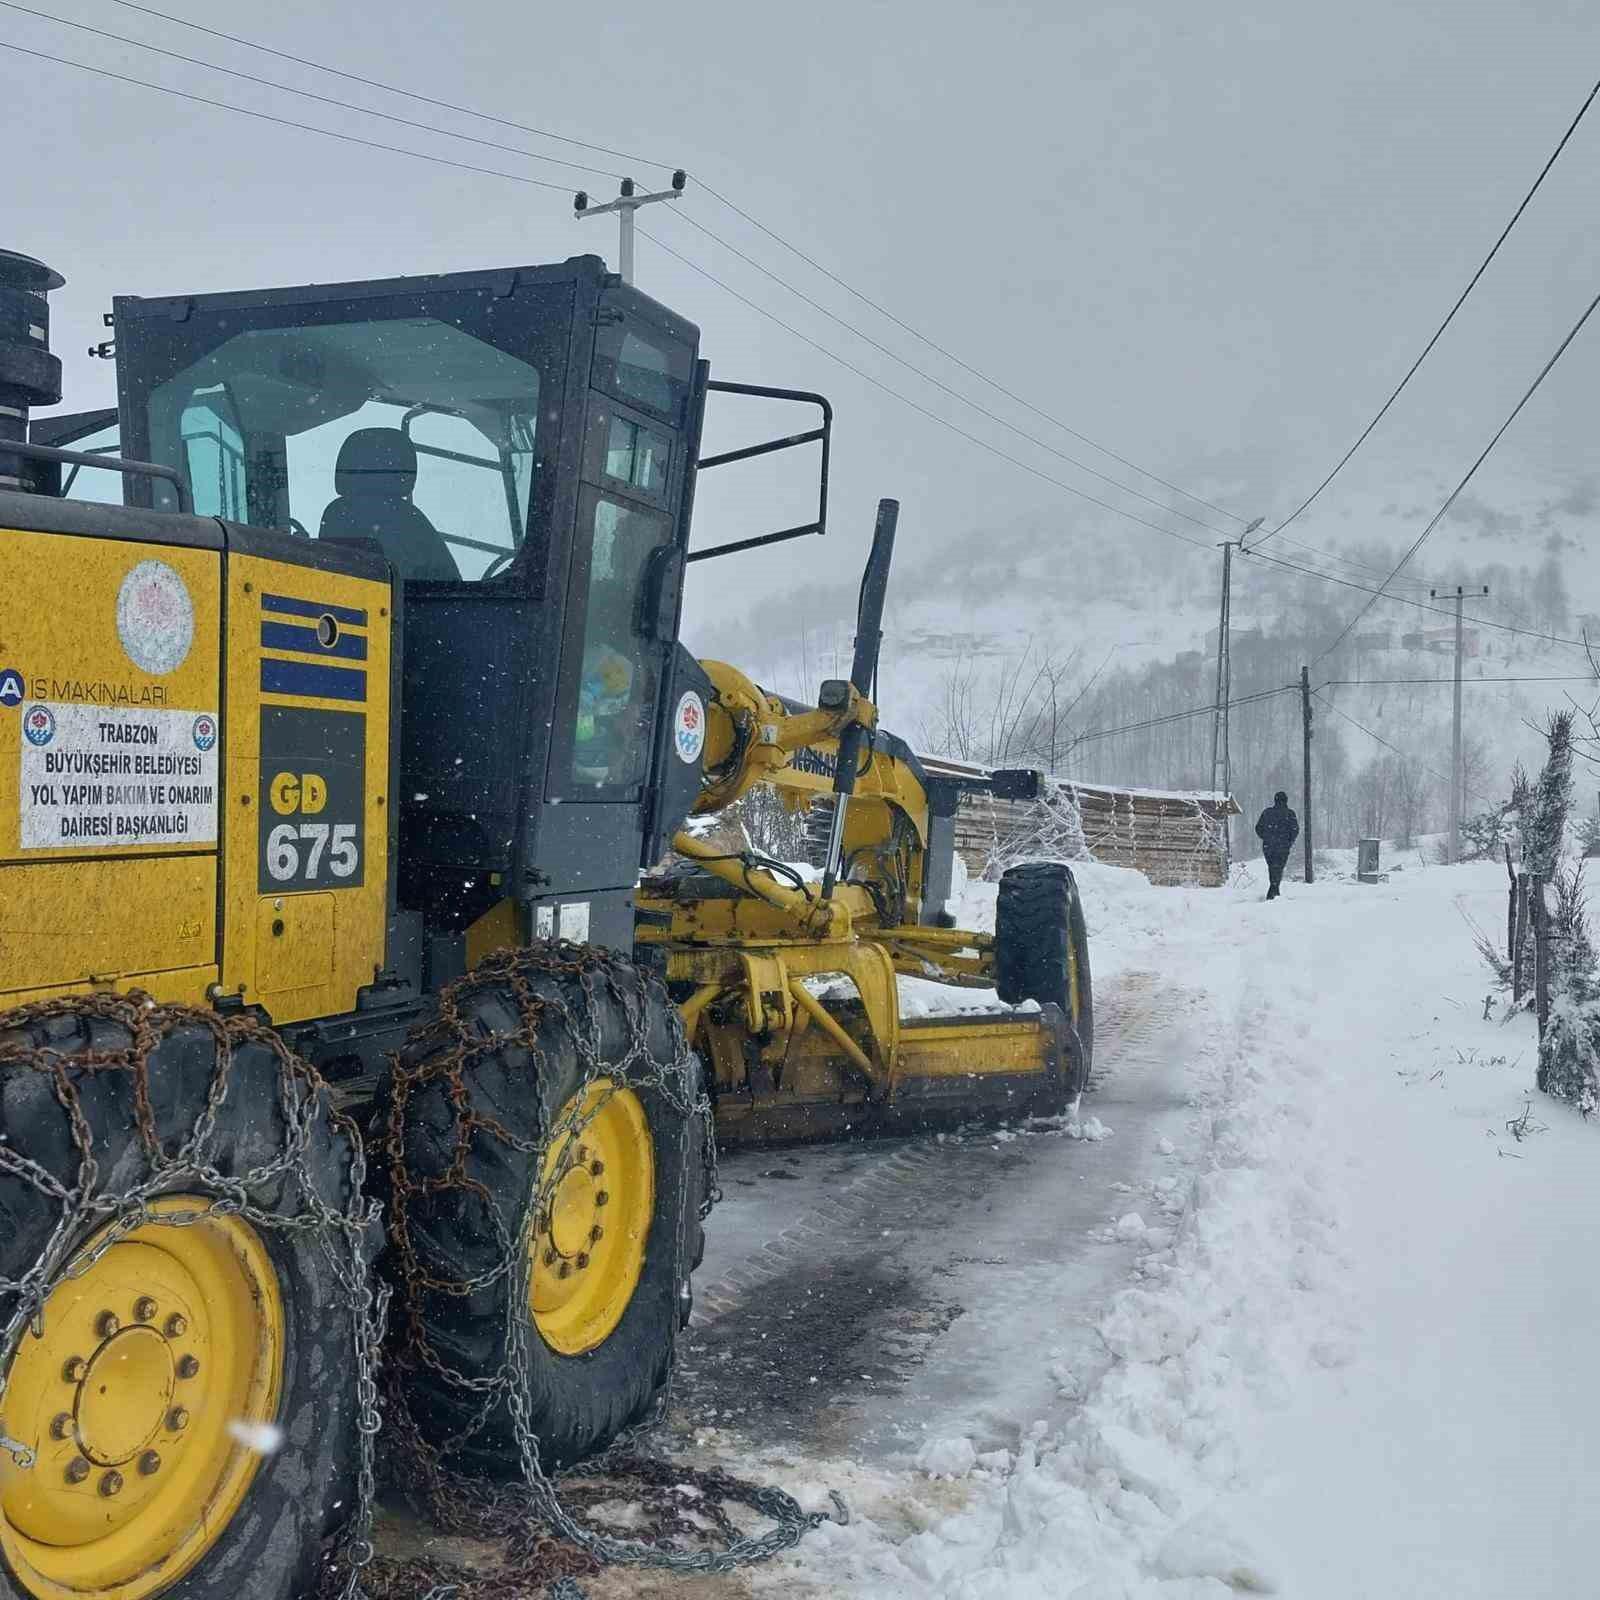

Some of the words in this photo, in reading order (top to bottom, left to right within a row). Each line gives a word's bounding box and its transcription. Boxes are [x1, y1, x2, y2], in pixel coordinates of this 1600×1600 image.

[99, 722, 158, 745] TRABZON
[45, 751, 131, 778] BÜYÜKŞEHİR
[135, 752, 202, 776] BELEDİYESİ
[31, 785, 58, 806] YOL
[62, 785, 103, 805] YAPIM
[106, 785, 146, 805] BAKIM
[150, 785, 165, 805] VE
[168, 785, 213, 805] ONARIM
[270, 771, 328, 816] GD
[60, 812, 112, 838] DAİRESİ
[116, 811, 188, 839] BAŞKANLIĞI
[266, 823, 359, 881] 675
